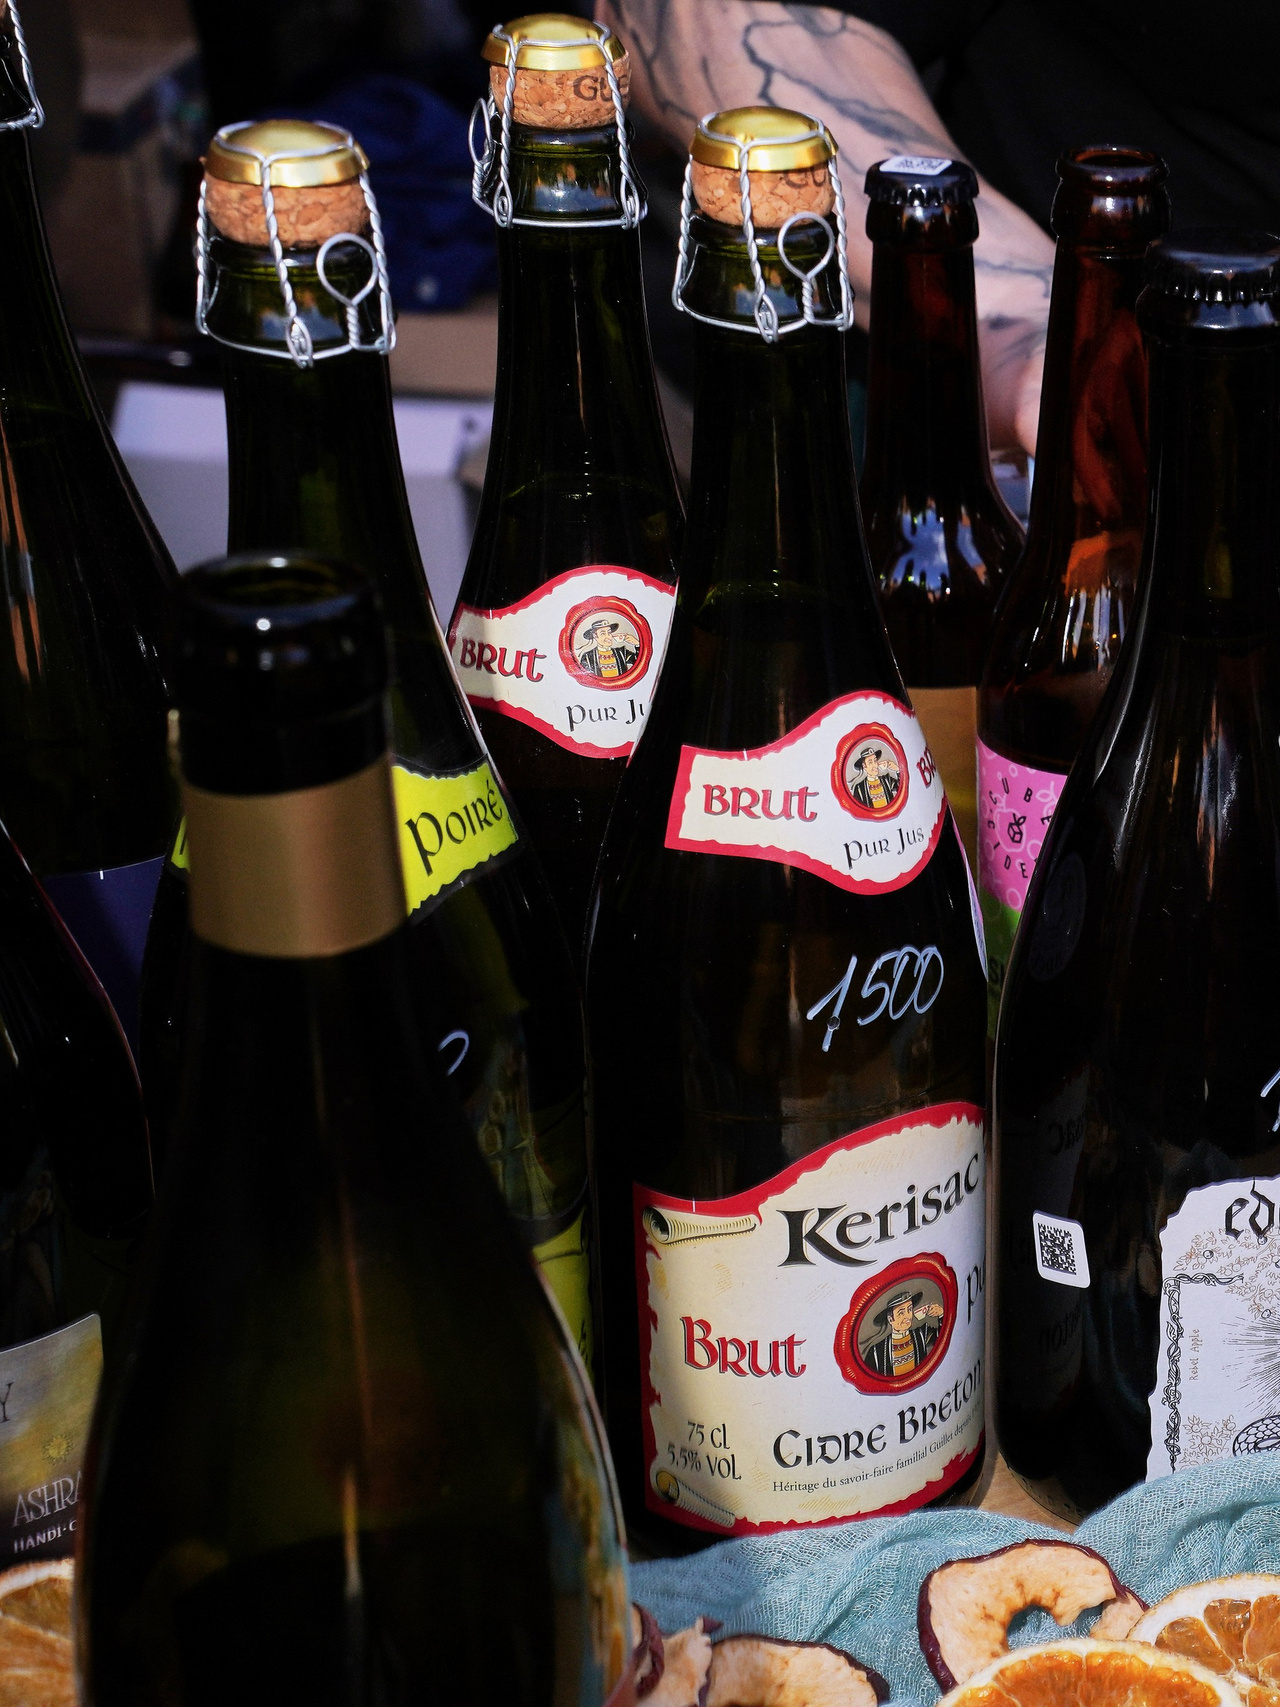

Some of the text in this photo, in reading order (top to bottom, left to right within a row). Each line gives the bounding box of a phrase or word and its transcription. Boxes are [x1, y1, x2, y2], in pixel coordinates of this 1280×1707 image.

[405, 781, 503, 877] Poiré
[806, 944, 945, 1052] 1500
[776, 1153, 980, 1268] Kerisac
[687, 1421, 706, 1446] 75
[772, 1480, 820, 1494] Héritage
[823, 1476, 837, 1488] du
[839, 1464, 894, 1485] savoir-faire
[896, 1447, 928, 1471] familial
